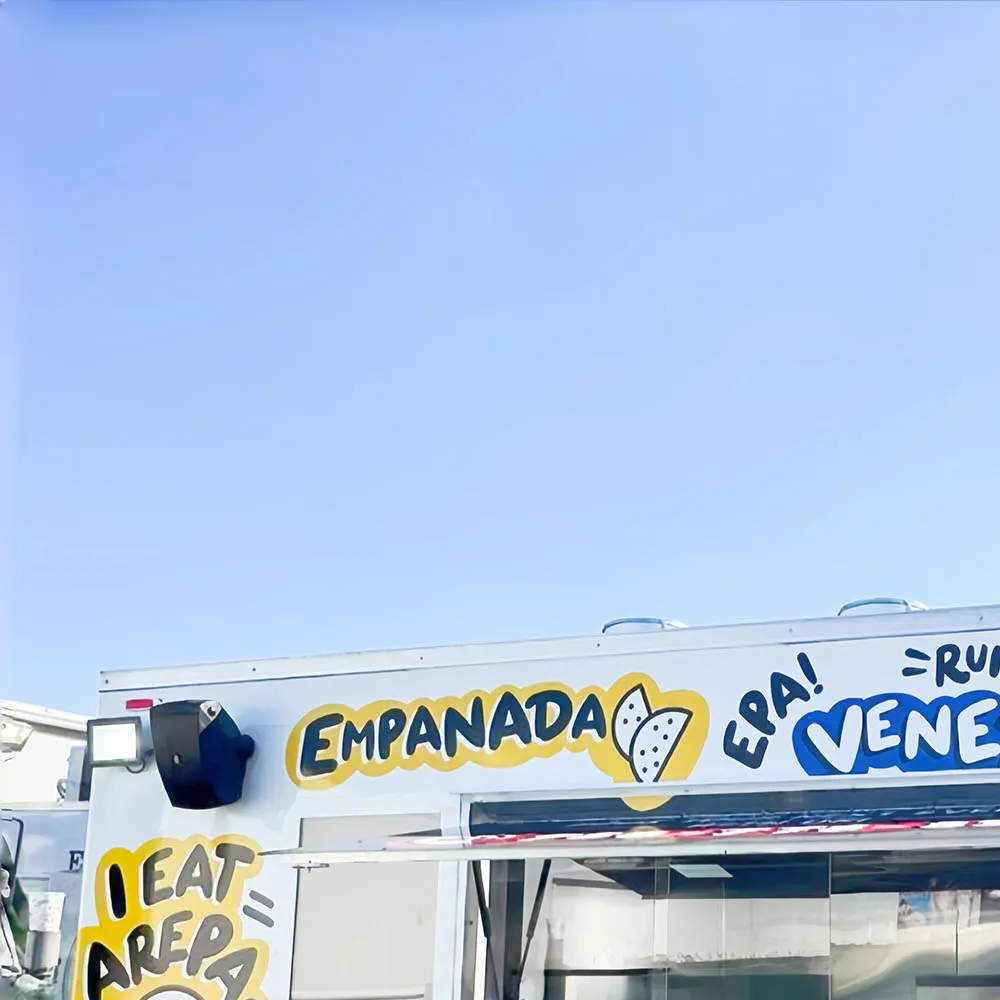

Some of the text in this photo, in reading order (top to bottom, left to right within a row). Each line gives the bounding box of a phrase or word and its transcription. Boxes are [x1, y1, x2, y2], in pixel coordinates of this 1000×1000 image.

[300, 692, 606, 778] EMPANADA
[723, 653, 824, 768] EPA!
[108, 842, 255, 919] I EAT
